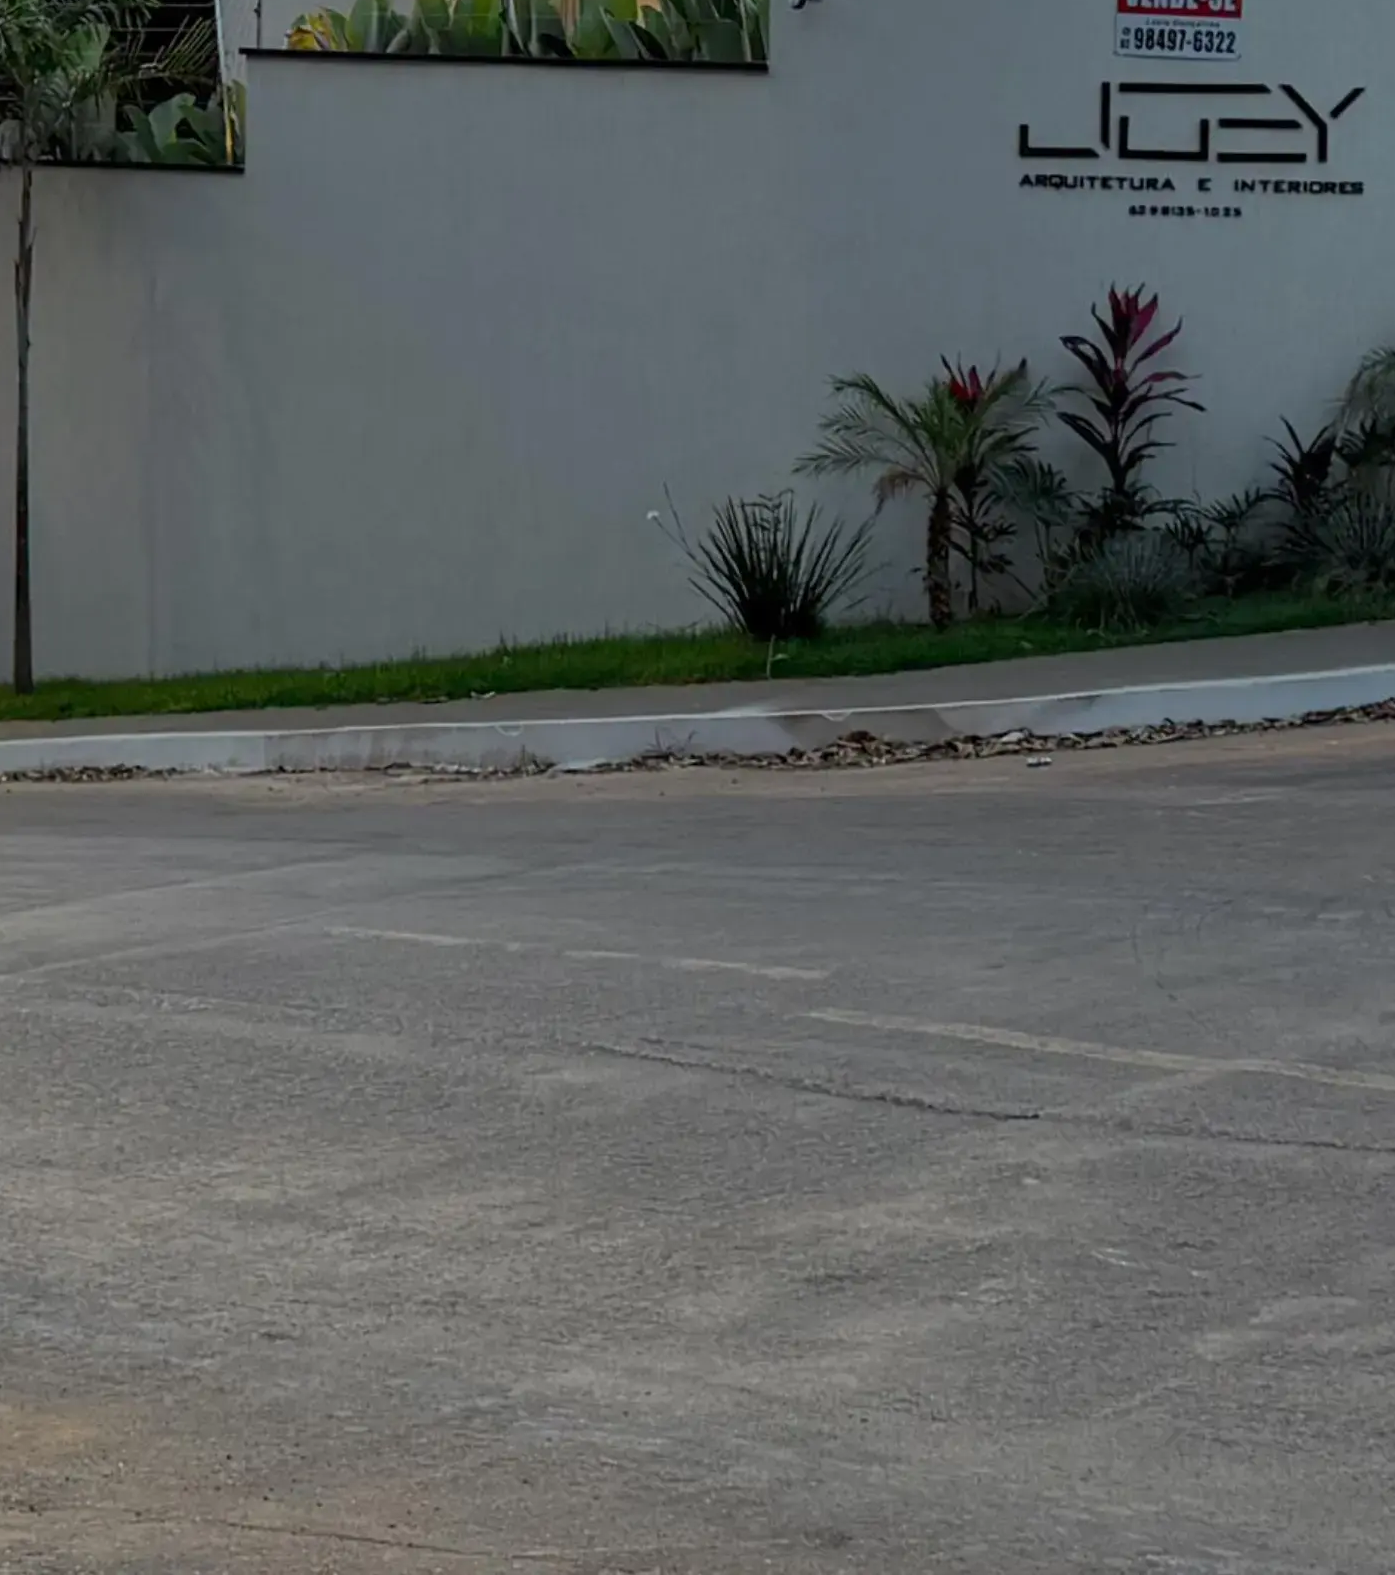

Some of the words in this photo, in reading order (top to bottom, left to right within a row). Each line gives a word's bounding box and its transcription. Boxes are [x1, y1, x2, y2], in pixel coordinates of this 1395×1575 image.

[1134, 27, 1237, 54] 98497-6322
[1019, 173, 1176, 192] ARQUITETURA
[1197, 177, 1212, 193] E
[1233, 179, 1365, 195] INTERIORES
